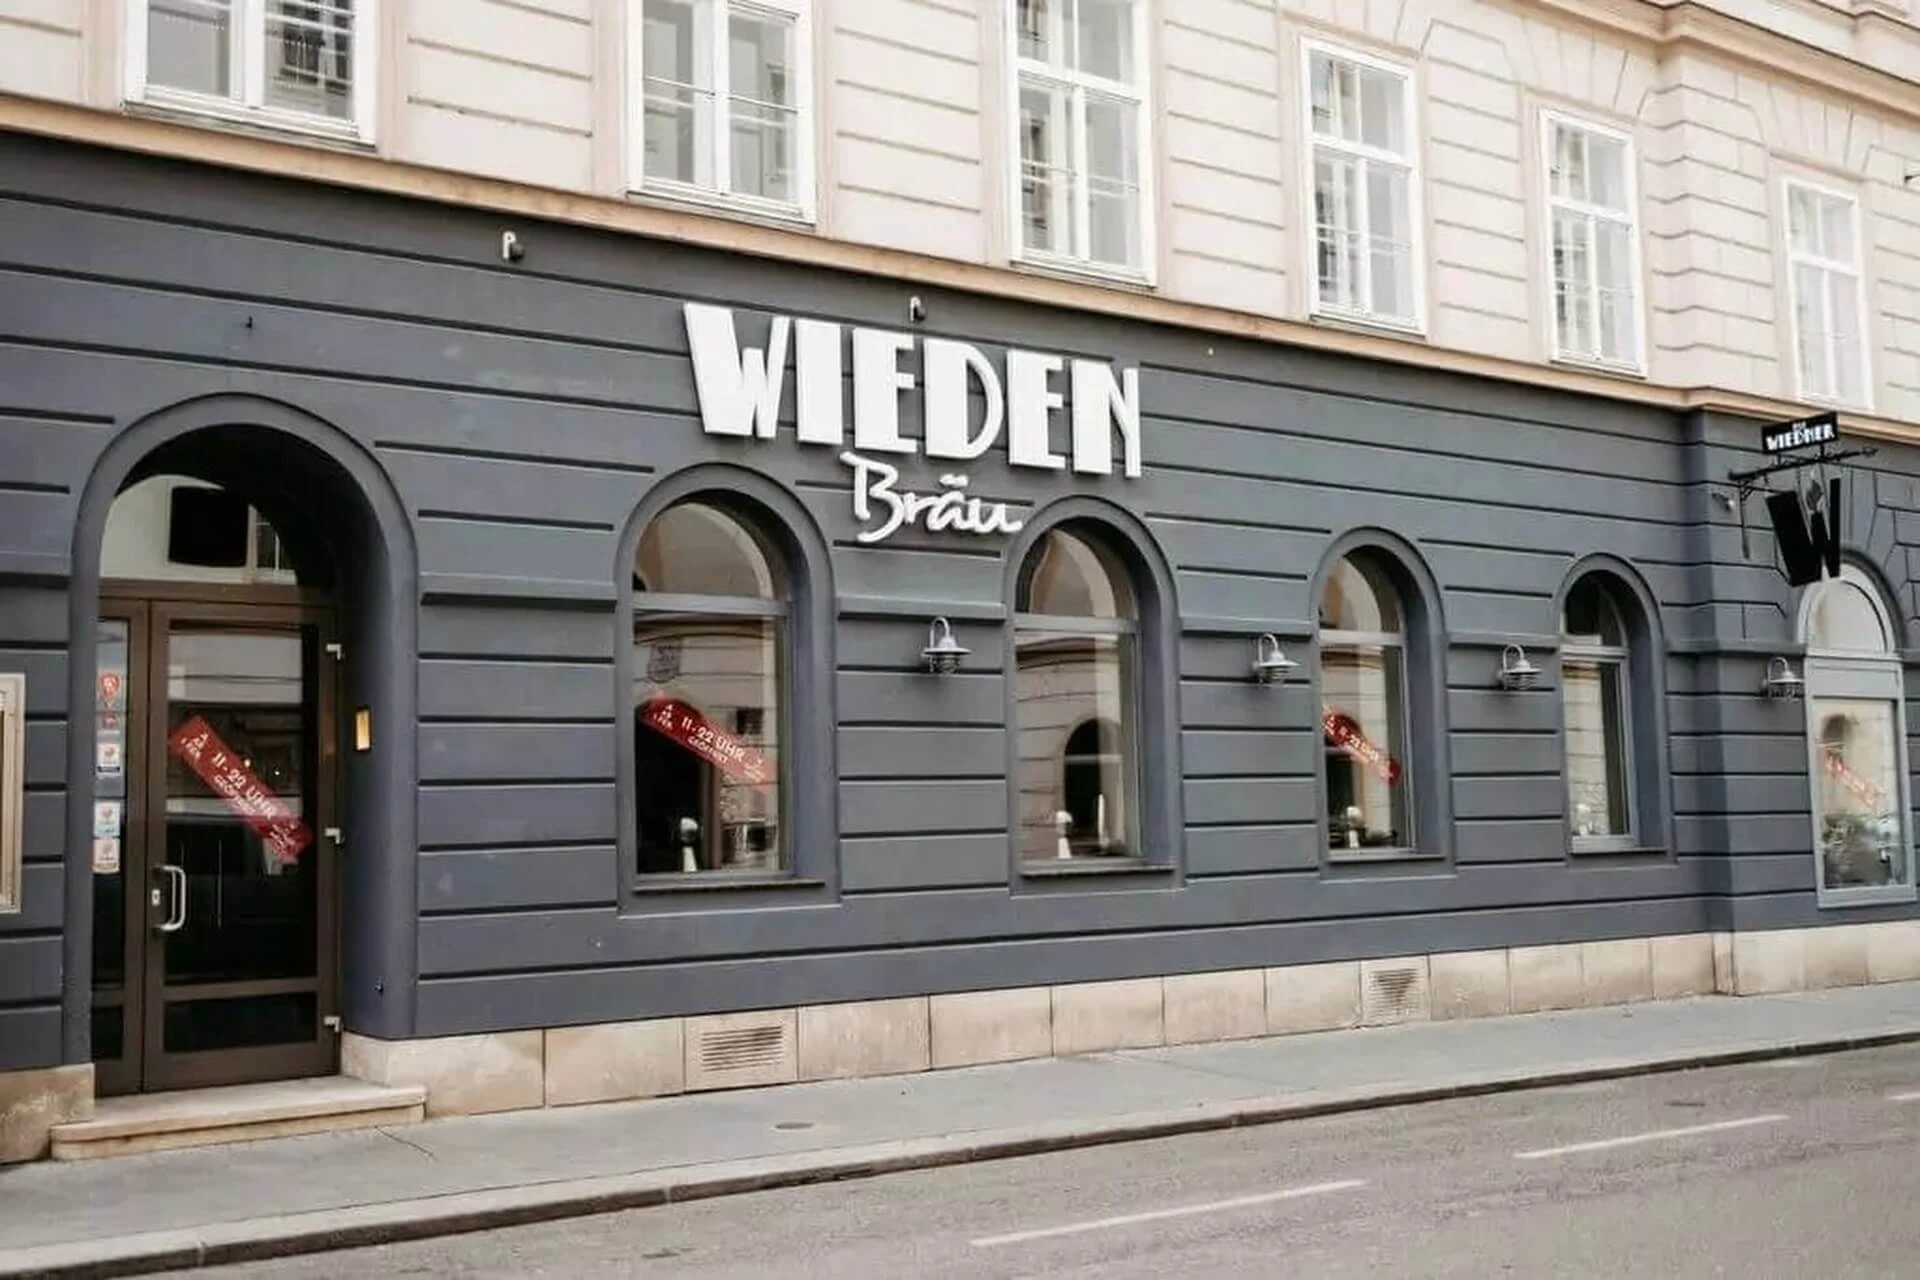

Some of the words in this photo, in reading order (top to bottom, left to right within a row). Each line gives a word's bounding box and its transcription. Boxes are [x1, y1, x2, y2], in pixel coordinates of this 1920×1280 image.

[684, 302, 1141, 478] WIEDEN
[1766, 424, 1835, 450] WIEDNER
[840, 452, 1023, 542] Bräu
[715, 736, 745, 762] UHR
